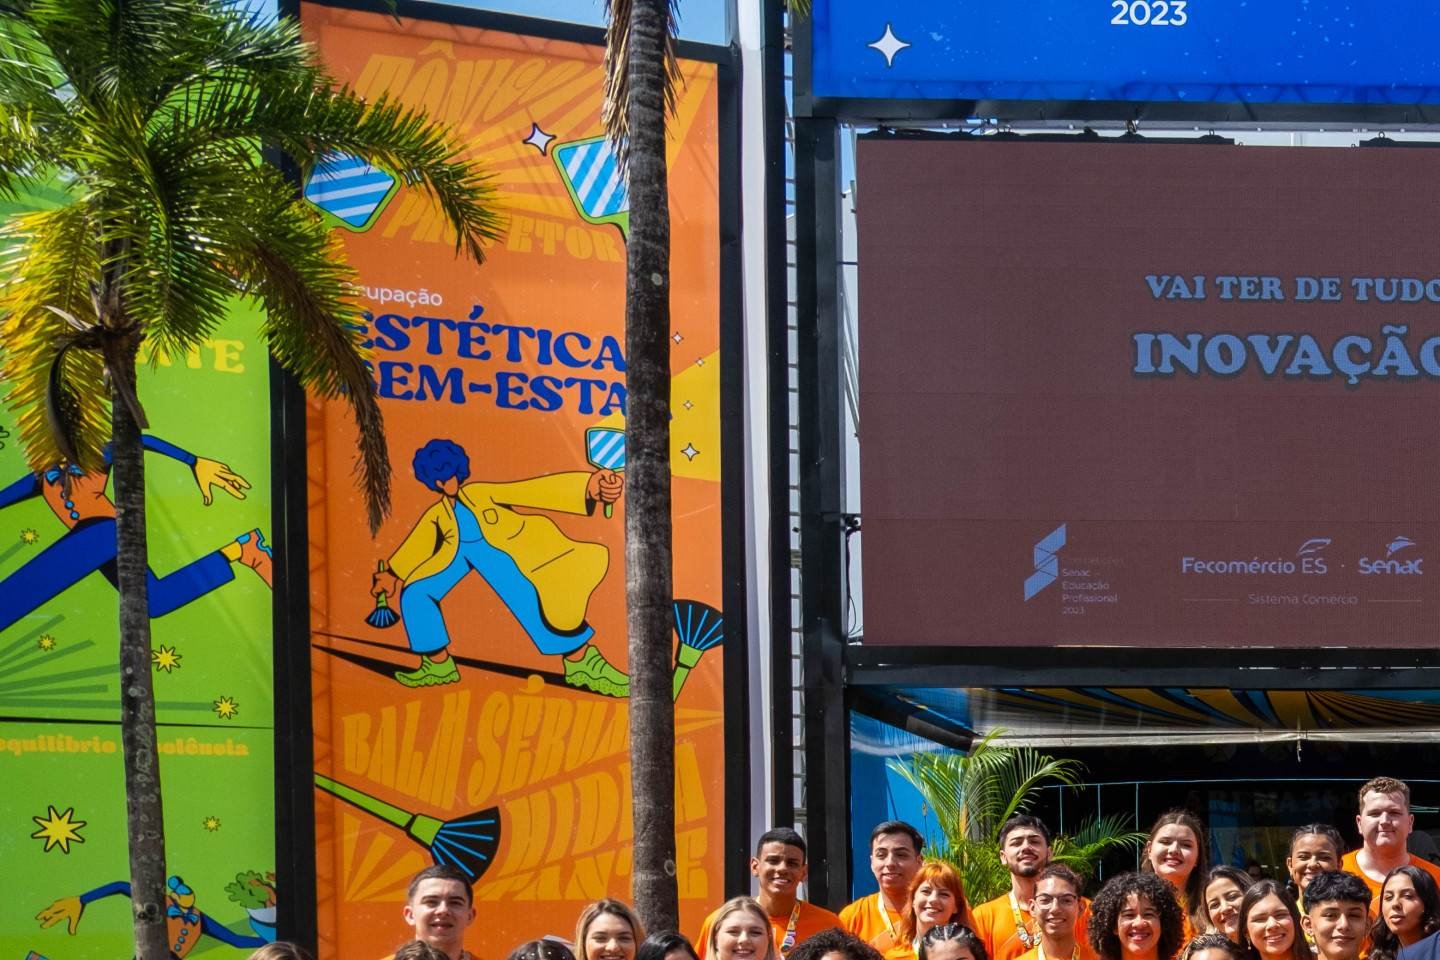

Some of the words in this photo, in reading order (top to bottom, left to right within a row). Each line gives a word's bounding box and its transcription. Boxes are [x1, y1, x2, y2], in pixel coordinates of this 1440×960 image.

[1110, 0, 1188, 26] 2023
[1145, 275, 1206, 299] VAI
[1215, 276, 1285, 300] TER
[1294, 277, 1342, 300] DE
[1182, 556, 1296, 575] Fecomércio
[1302, 557, 1329, 575] ES
[1358, 557, 1424, 576] Senac
[1248, 593, 1300, 606] Sistema
[1302, 593, 1359, 606] Comércio
